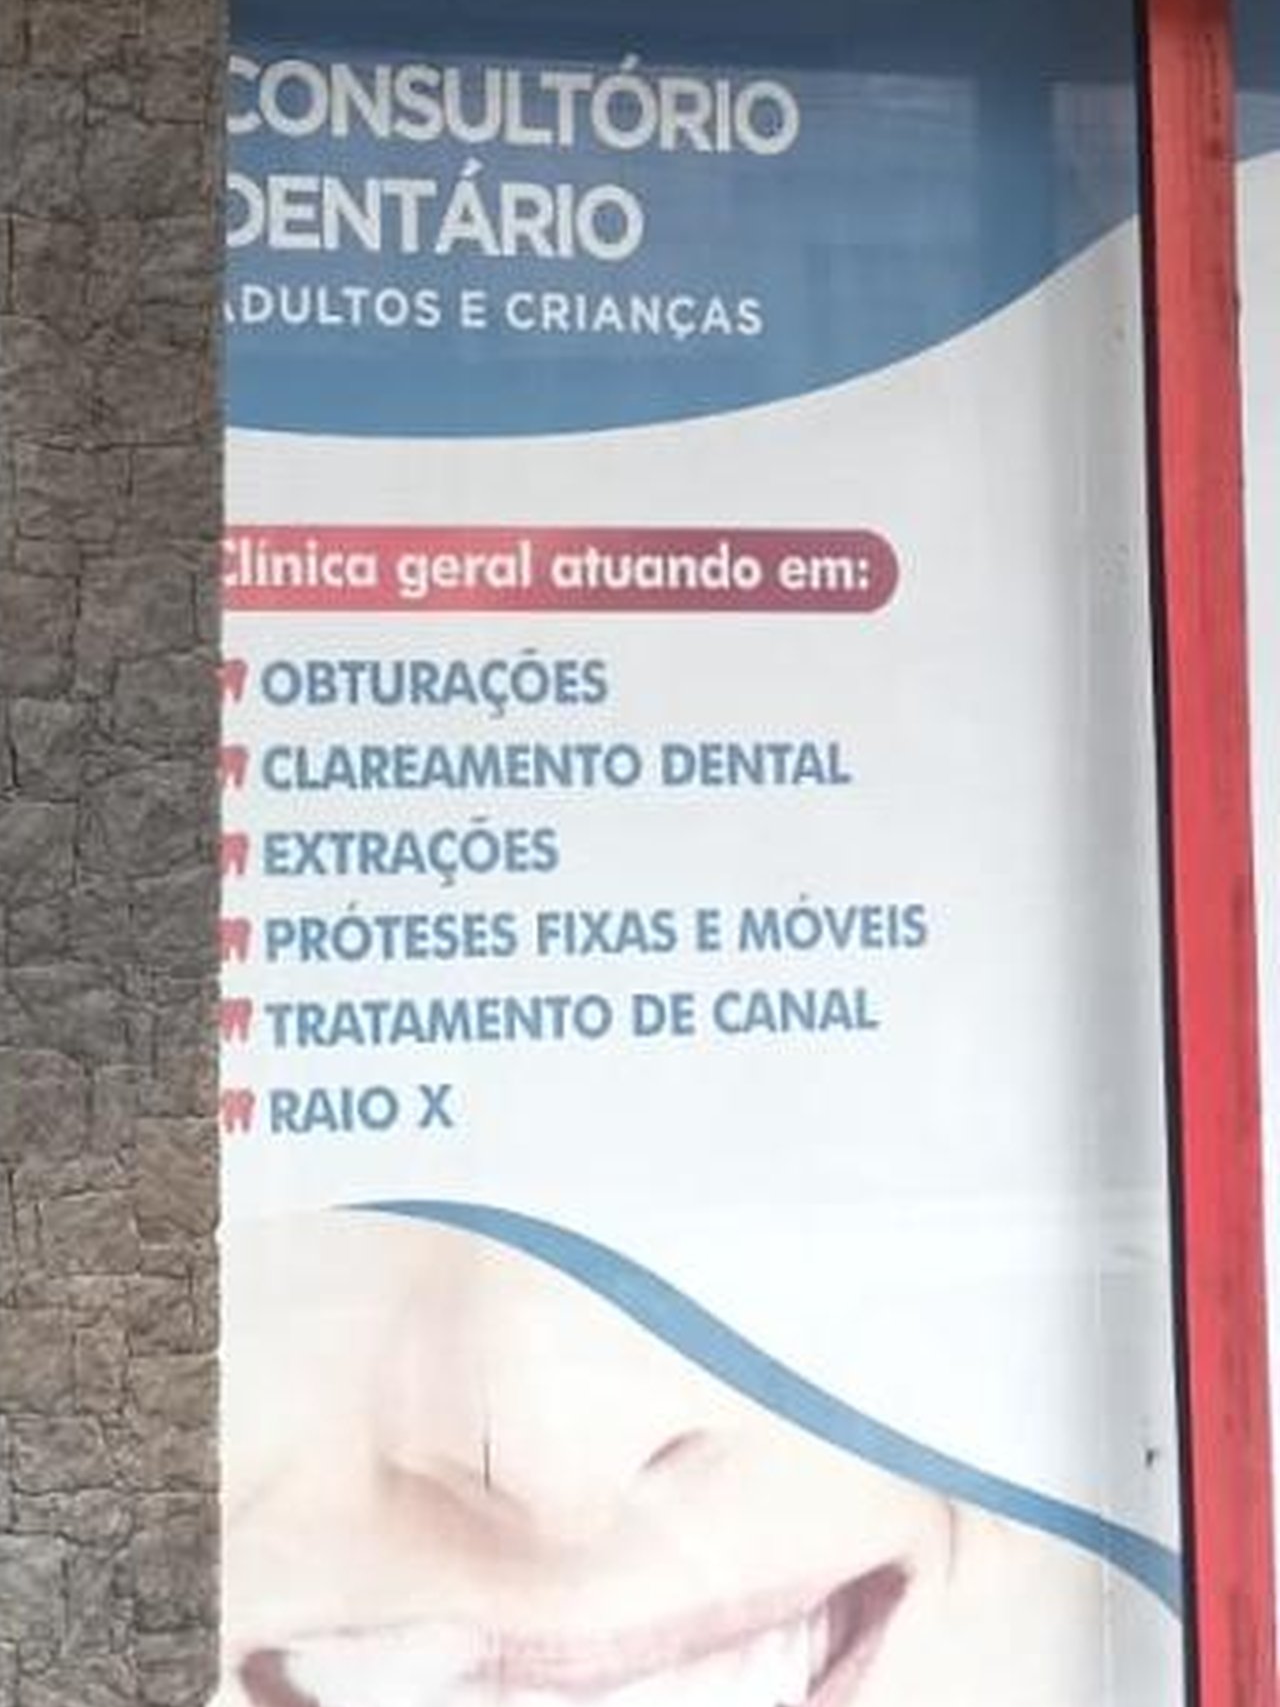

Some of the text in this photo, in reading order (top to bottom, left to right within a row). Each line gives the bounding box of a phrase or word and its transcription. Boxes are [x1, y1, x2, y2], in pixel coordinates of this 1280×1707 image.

[224, 284, 763, 340] DULTOS E CRIANÇAS
[396, 539, 532, 598] geral
[551, 542, 763, 590] atuando
[778, 554, 871, 591] em:
[261, 647, 609, 719] OBTURAÇÕES
[261, 741, 853, 791] CLAREAMENTO DENTAL
[262, 814, 561, 888] EXTRAÇÕES
[265, 892, 928, 962] PRÓTESES FIXAS E MÓVEIS
[264, 987, 880, 1048] TRATAMENTO DE CANAL
[268, 1082, 455, 1134] RAIO X
